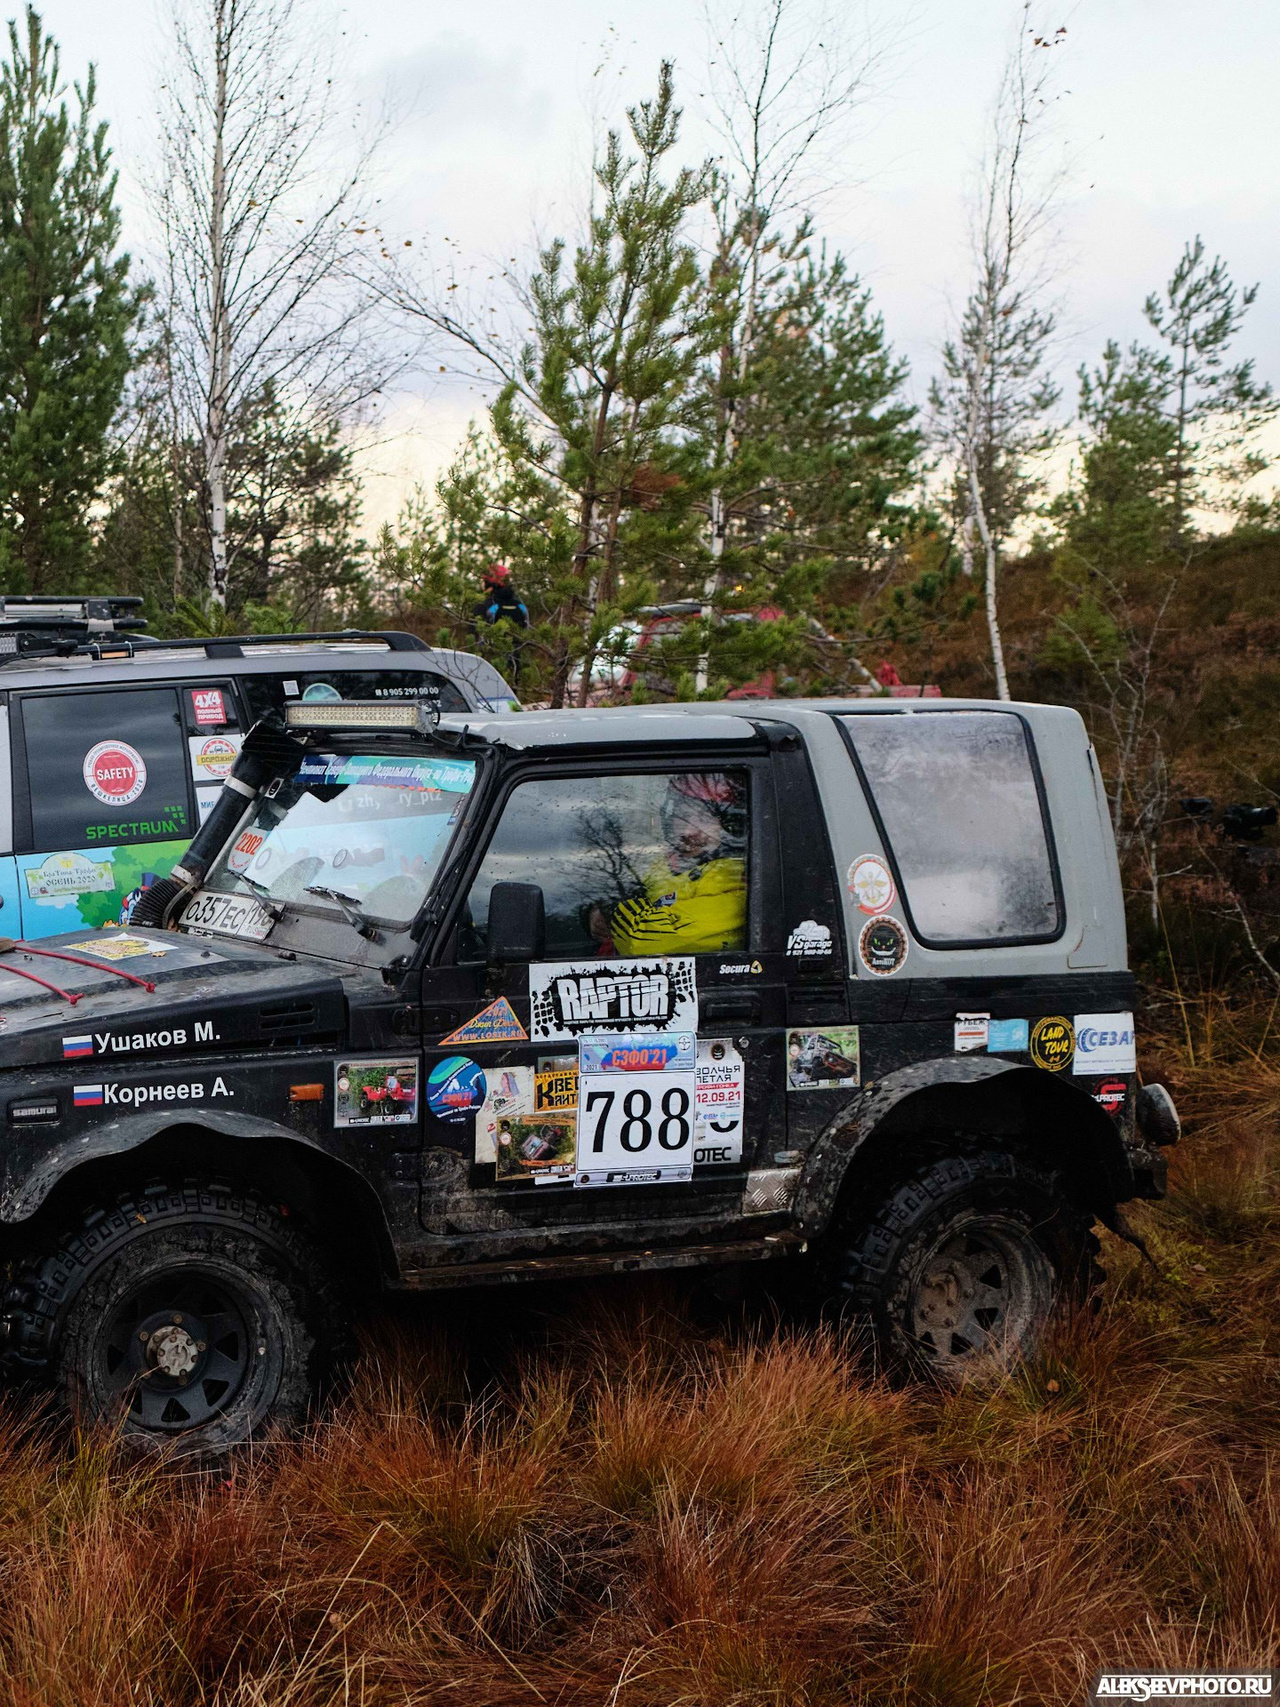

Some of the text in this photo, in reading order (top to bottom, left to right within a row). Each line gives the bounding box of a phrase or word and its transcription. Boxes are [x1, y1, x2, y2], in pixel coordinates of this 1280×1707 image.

[389, 688, 403, 696] 905
[404, 688, 417, 696] 299
[97, 766, 134, 781] SAFETY
[86, 820, 178, 840] SPECTRUM
[235, 832, 263, 856] 2202
[803, 941, 833, 951] garage
[720, 963, 750, 974] Secura
[557, 974, 669, 1020] RAPTOR
[95, 1021, 221, 1053] Ушаков М.
[453, 1030, 524, 1042] WWW.LOSIK.RU
[1041, 1025, 1065, 1041] LAND
[1045, 1039, 1069, 1055] TOUR
[104, 1076, 234, 1107] Корнеев А.
[586, 1087, 690, 1153] 788
